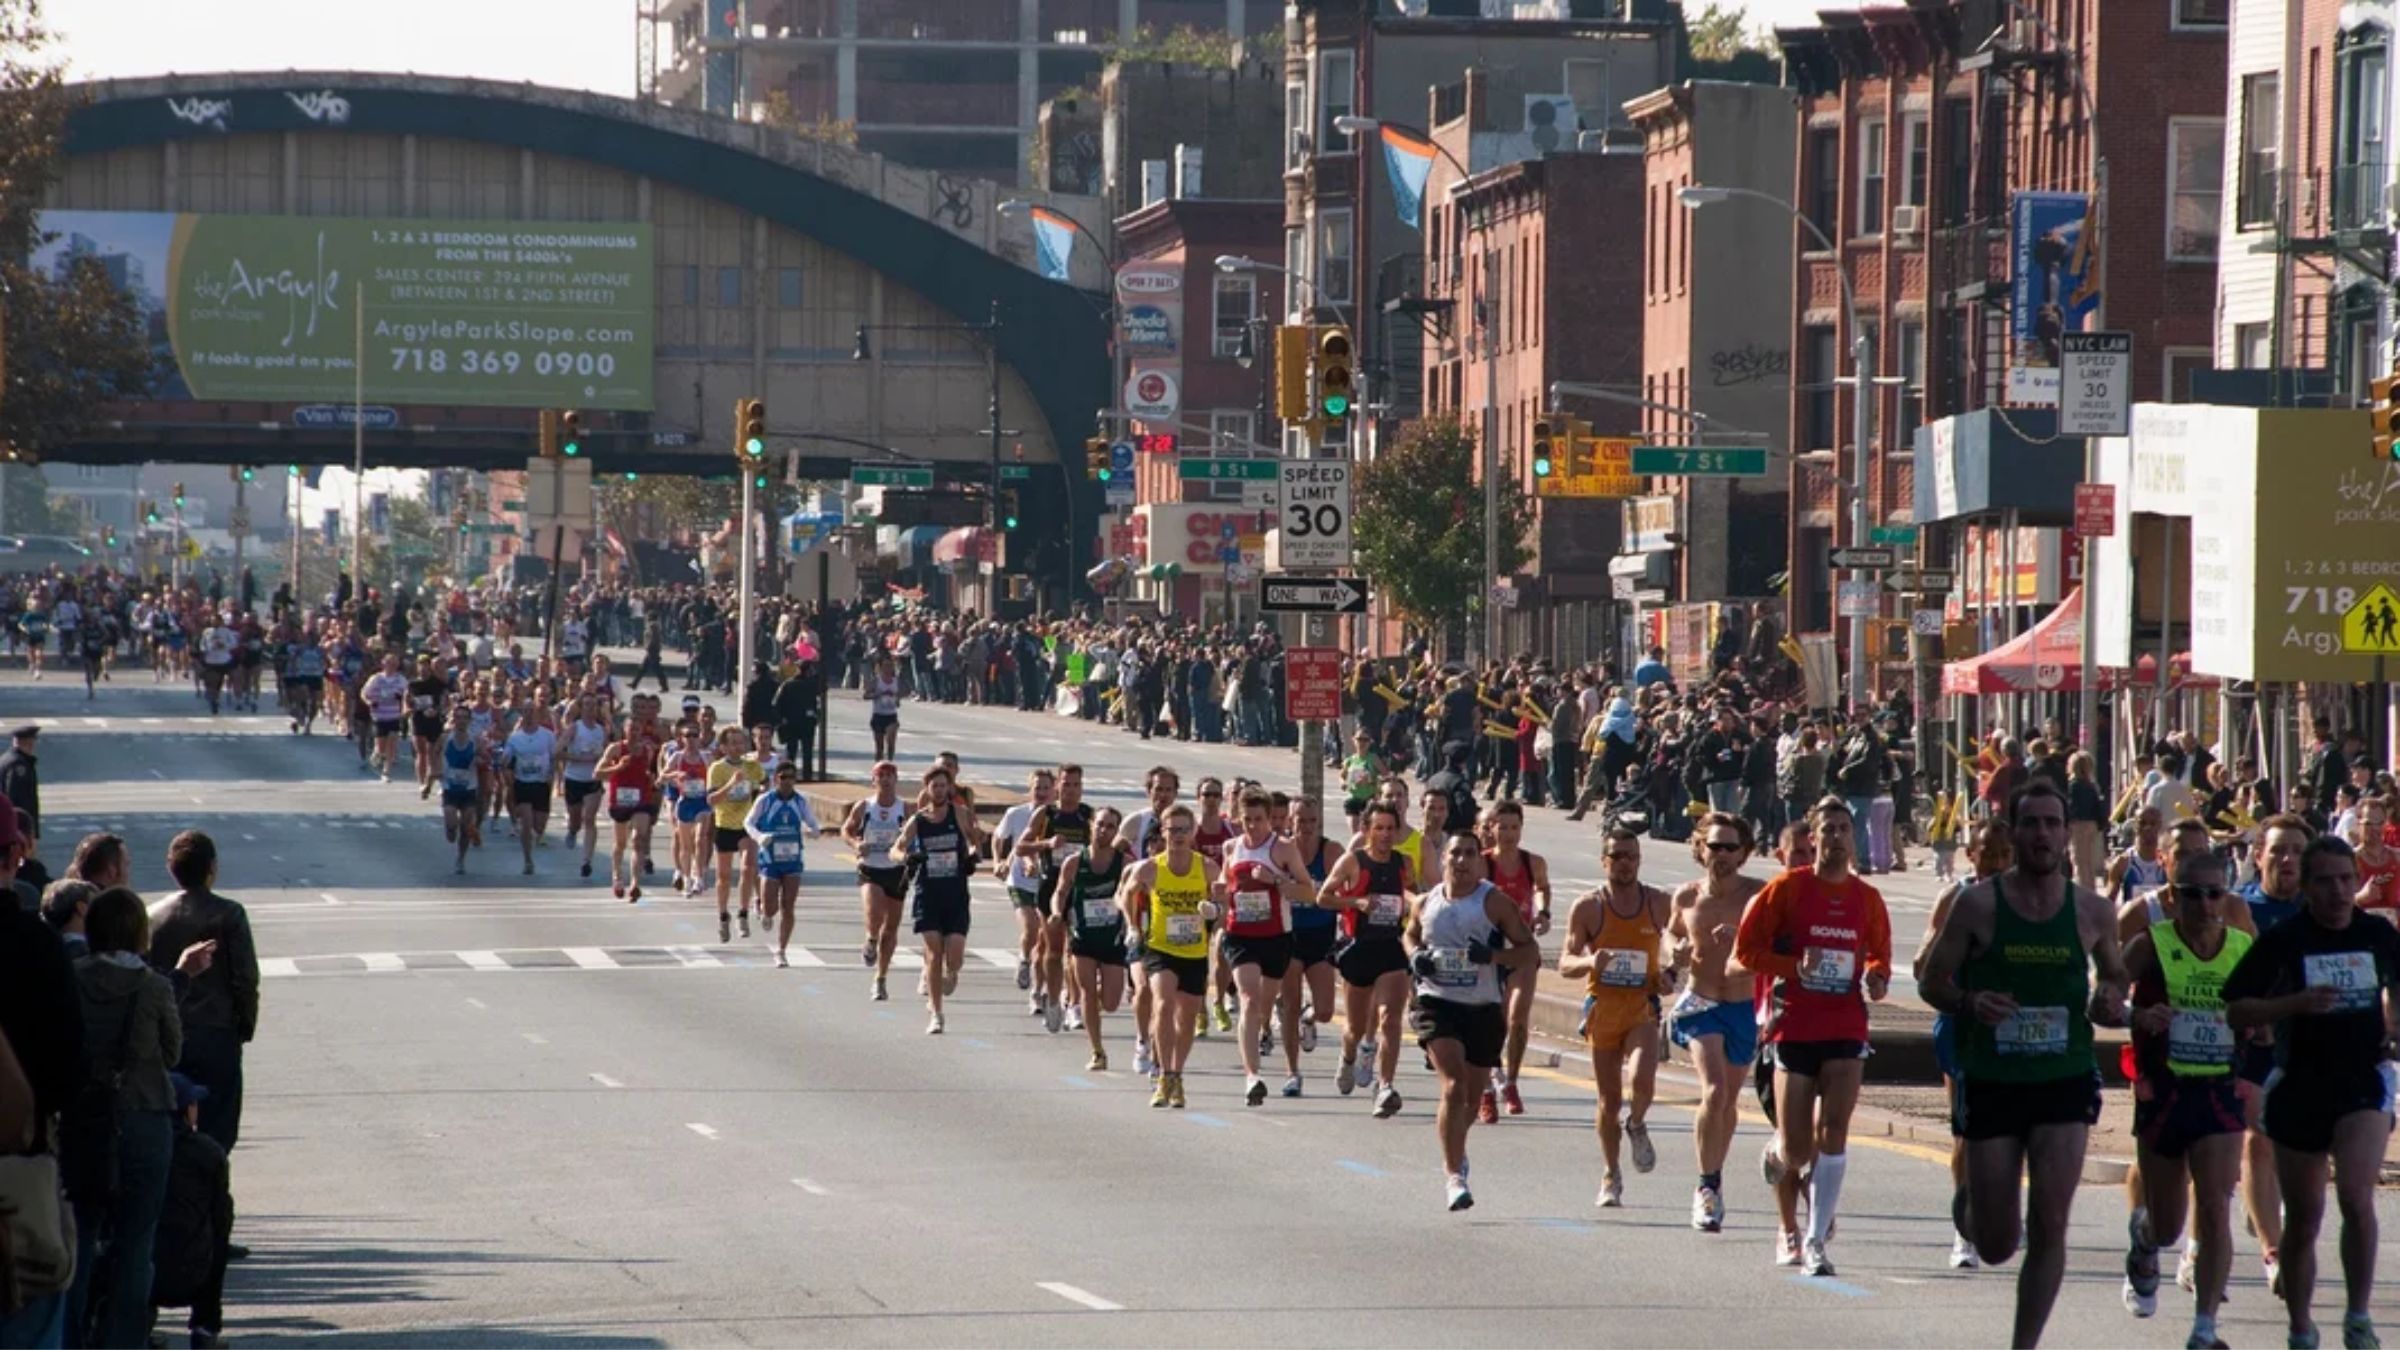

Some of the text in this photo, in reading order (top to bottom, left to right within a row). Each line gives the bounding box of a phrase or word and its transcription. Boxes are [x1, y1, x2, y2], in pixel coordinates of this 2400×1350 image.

[390, 231, 399, 243] 2
[403, 232, 414, 244] &
[419, 232, 429, 245] 3
[433, 232, 509, 247] BEDROOM
[512, 234, 638, 249] CONDOMINIUMS
[436, 249, 479, 262] FROM
[484, 249, 510, 263] THE
[375, 268, 420, 282] SALES
[571, 272, 632, 287] AVENUE
[221, 229, 340, 347] Argyle
[520, 288, 553, 303] 2ND
[373, 319, 635, 344] ArgyleParkSlope.com
[2065, 337, 2129, 351] NYC LAW
[207, 351, 250, 366] looks
[254, 352, 296, 370] good
[299, 357, 321, 367] on
[389, 347, 616, 378] 718 369 0900
[2076, 355, 2117, 366] SPEED
[2080, 367, 2112, 379] LIMIT
[2083, 383, 2108, 398] 30
[2079, 401, 2111, 410] UNLESS
[303, 409, 334, 423] Van
[2071, 411, 2117, 420] OTHERWISE
[2078, 422, 2110, 431] POSTED
[1674, 452, 1725, 470] 7 St
[1209, 464, 1248, 476] 8 St
[1284, 468, 1344, 482] SPEED
[2337, 467, 2374, 501] the
[1291, 486, 1338, 500] LIMIT
[1286, 503, 1342, 538] 30
[2335, 506, 2372, 525] park
[2284, 560, 2298, 576] 1,
[2304, 561, 2314, 574] 2
[2319, 561, 2331, 575] &
[2336, 561, 2347, 575] 3
[1270, 587, 1349, 602] ONE WAY
[2285, 586, 2357, 615] 718
[1809, 925, 1858, 940] SCANIA
[2003, 945, 2071, 958] BROOKLYN
[2193, 1025, 2217, 1044] 476
